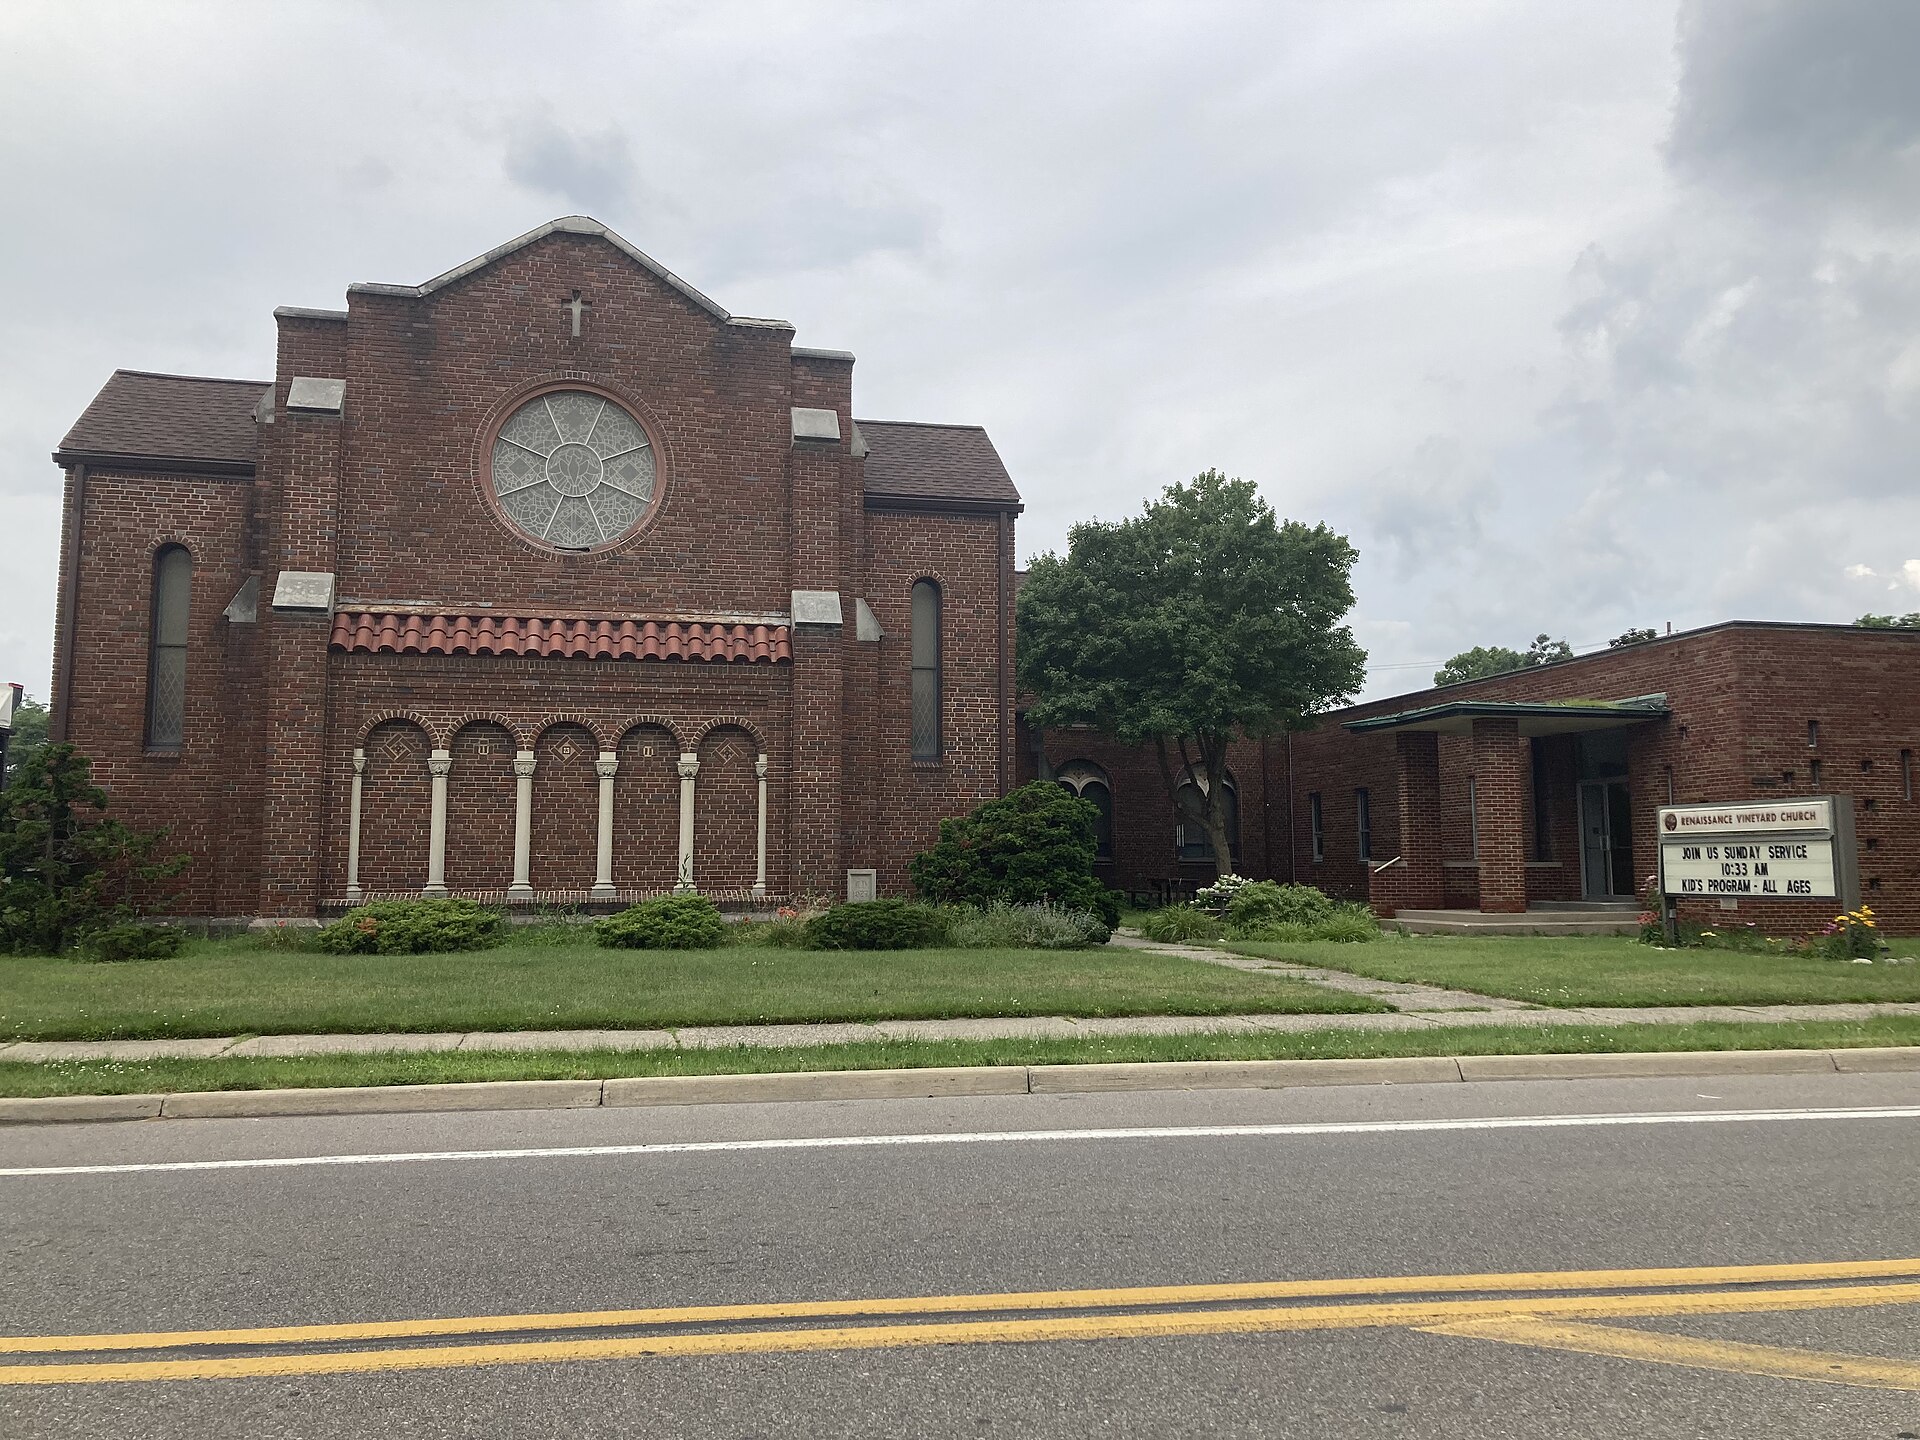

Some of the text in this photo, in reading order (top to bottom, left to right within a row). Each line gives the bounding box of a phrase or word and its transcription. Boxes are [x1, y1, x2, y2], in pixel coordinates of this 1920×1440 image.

[1680, 811, 1816, 826] RENAISSANCE VINEYARD CHURCH
[1681, 845, 1807, 859] JOIN US SUNDAY SERVICE
[1721, 863, 1768, 876] 10:33 AM
[1681, 879, 1703, 892] KID'S
[1708, 880, 1750, 892] PROGRAM
[1762, 880, 1778, 893] ALL
[1787, 880, 1811, 894] AGES
